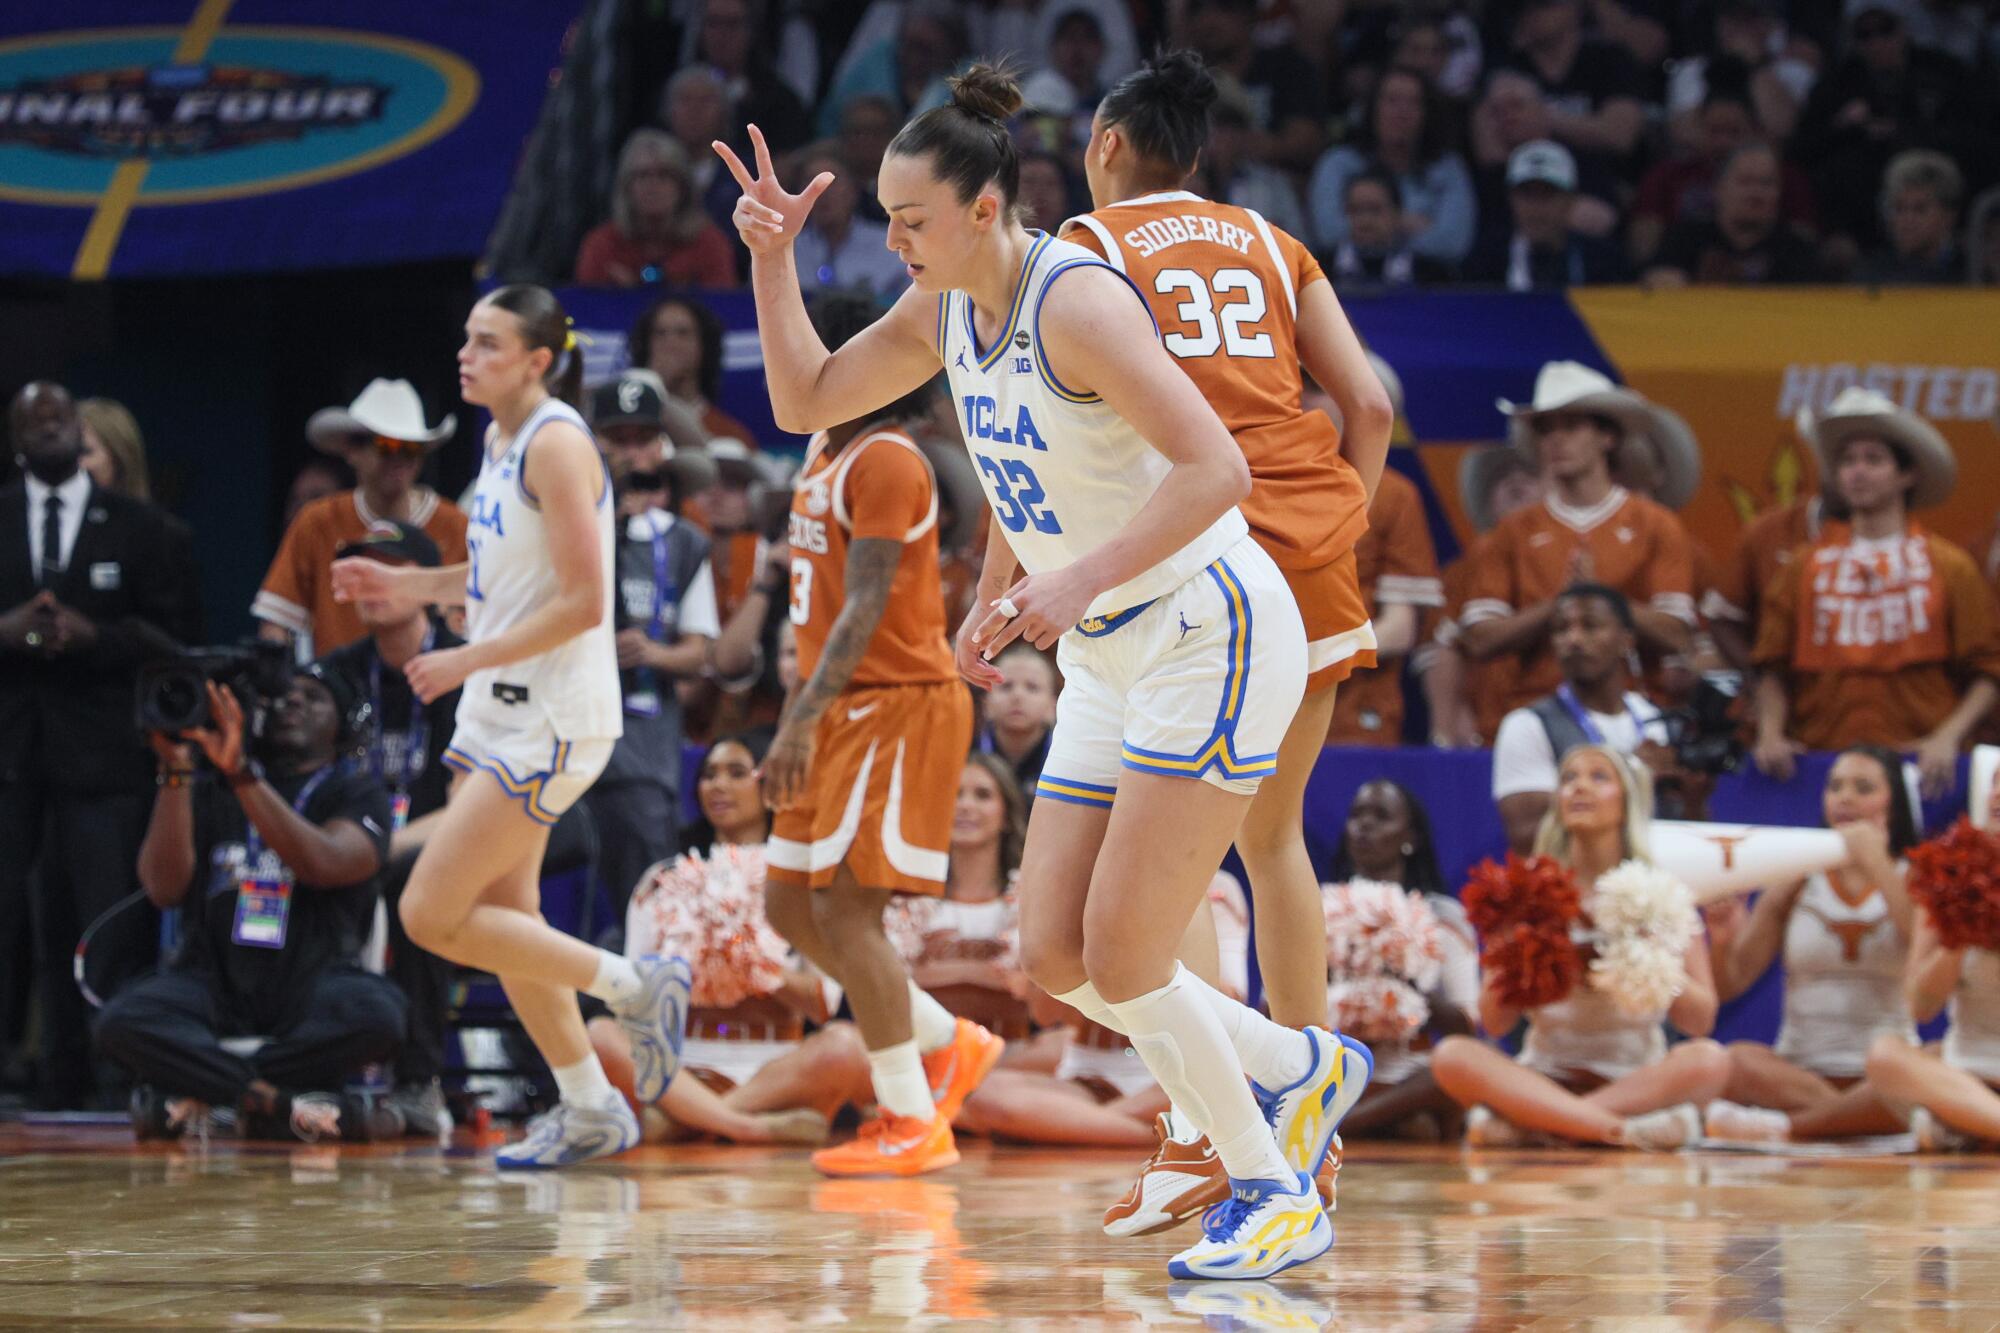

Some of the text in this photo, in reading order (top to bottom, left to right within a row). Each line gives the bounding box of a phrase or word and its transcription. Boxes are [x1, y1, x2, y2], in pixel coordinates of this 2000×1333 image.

[172, 88, 376, 122] FOUR
[1124, 214, 1255, 258] SIDBERRY
[1153, 267, 1276, 359] 32
[962, 395, 1048, 451] UCLA
[975, 452, 1063, 535] 32
[789, 556, 814, 626] 3
[1812, 534, 1933, 594] TEXAS
[1812, 586, 1930, 648] FIGHT
